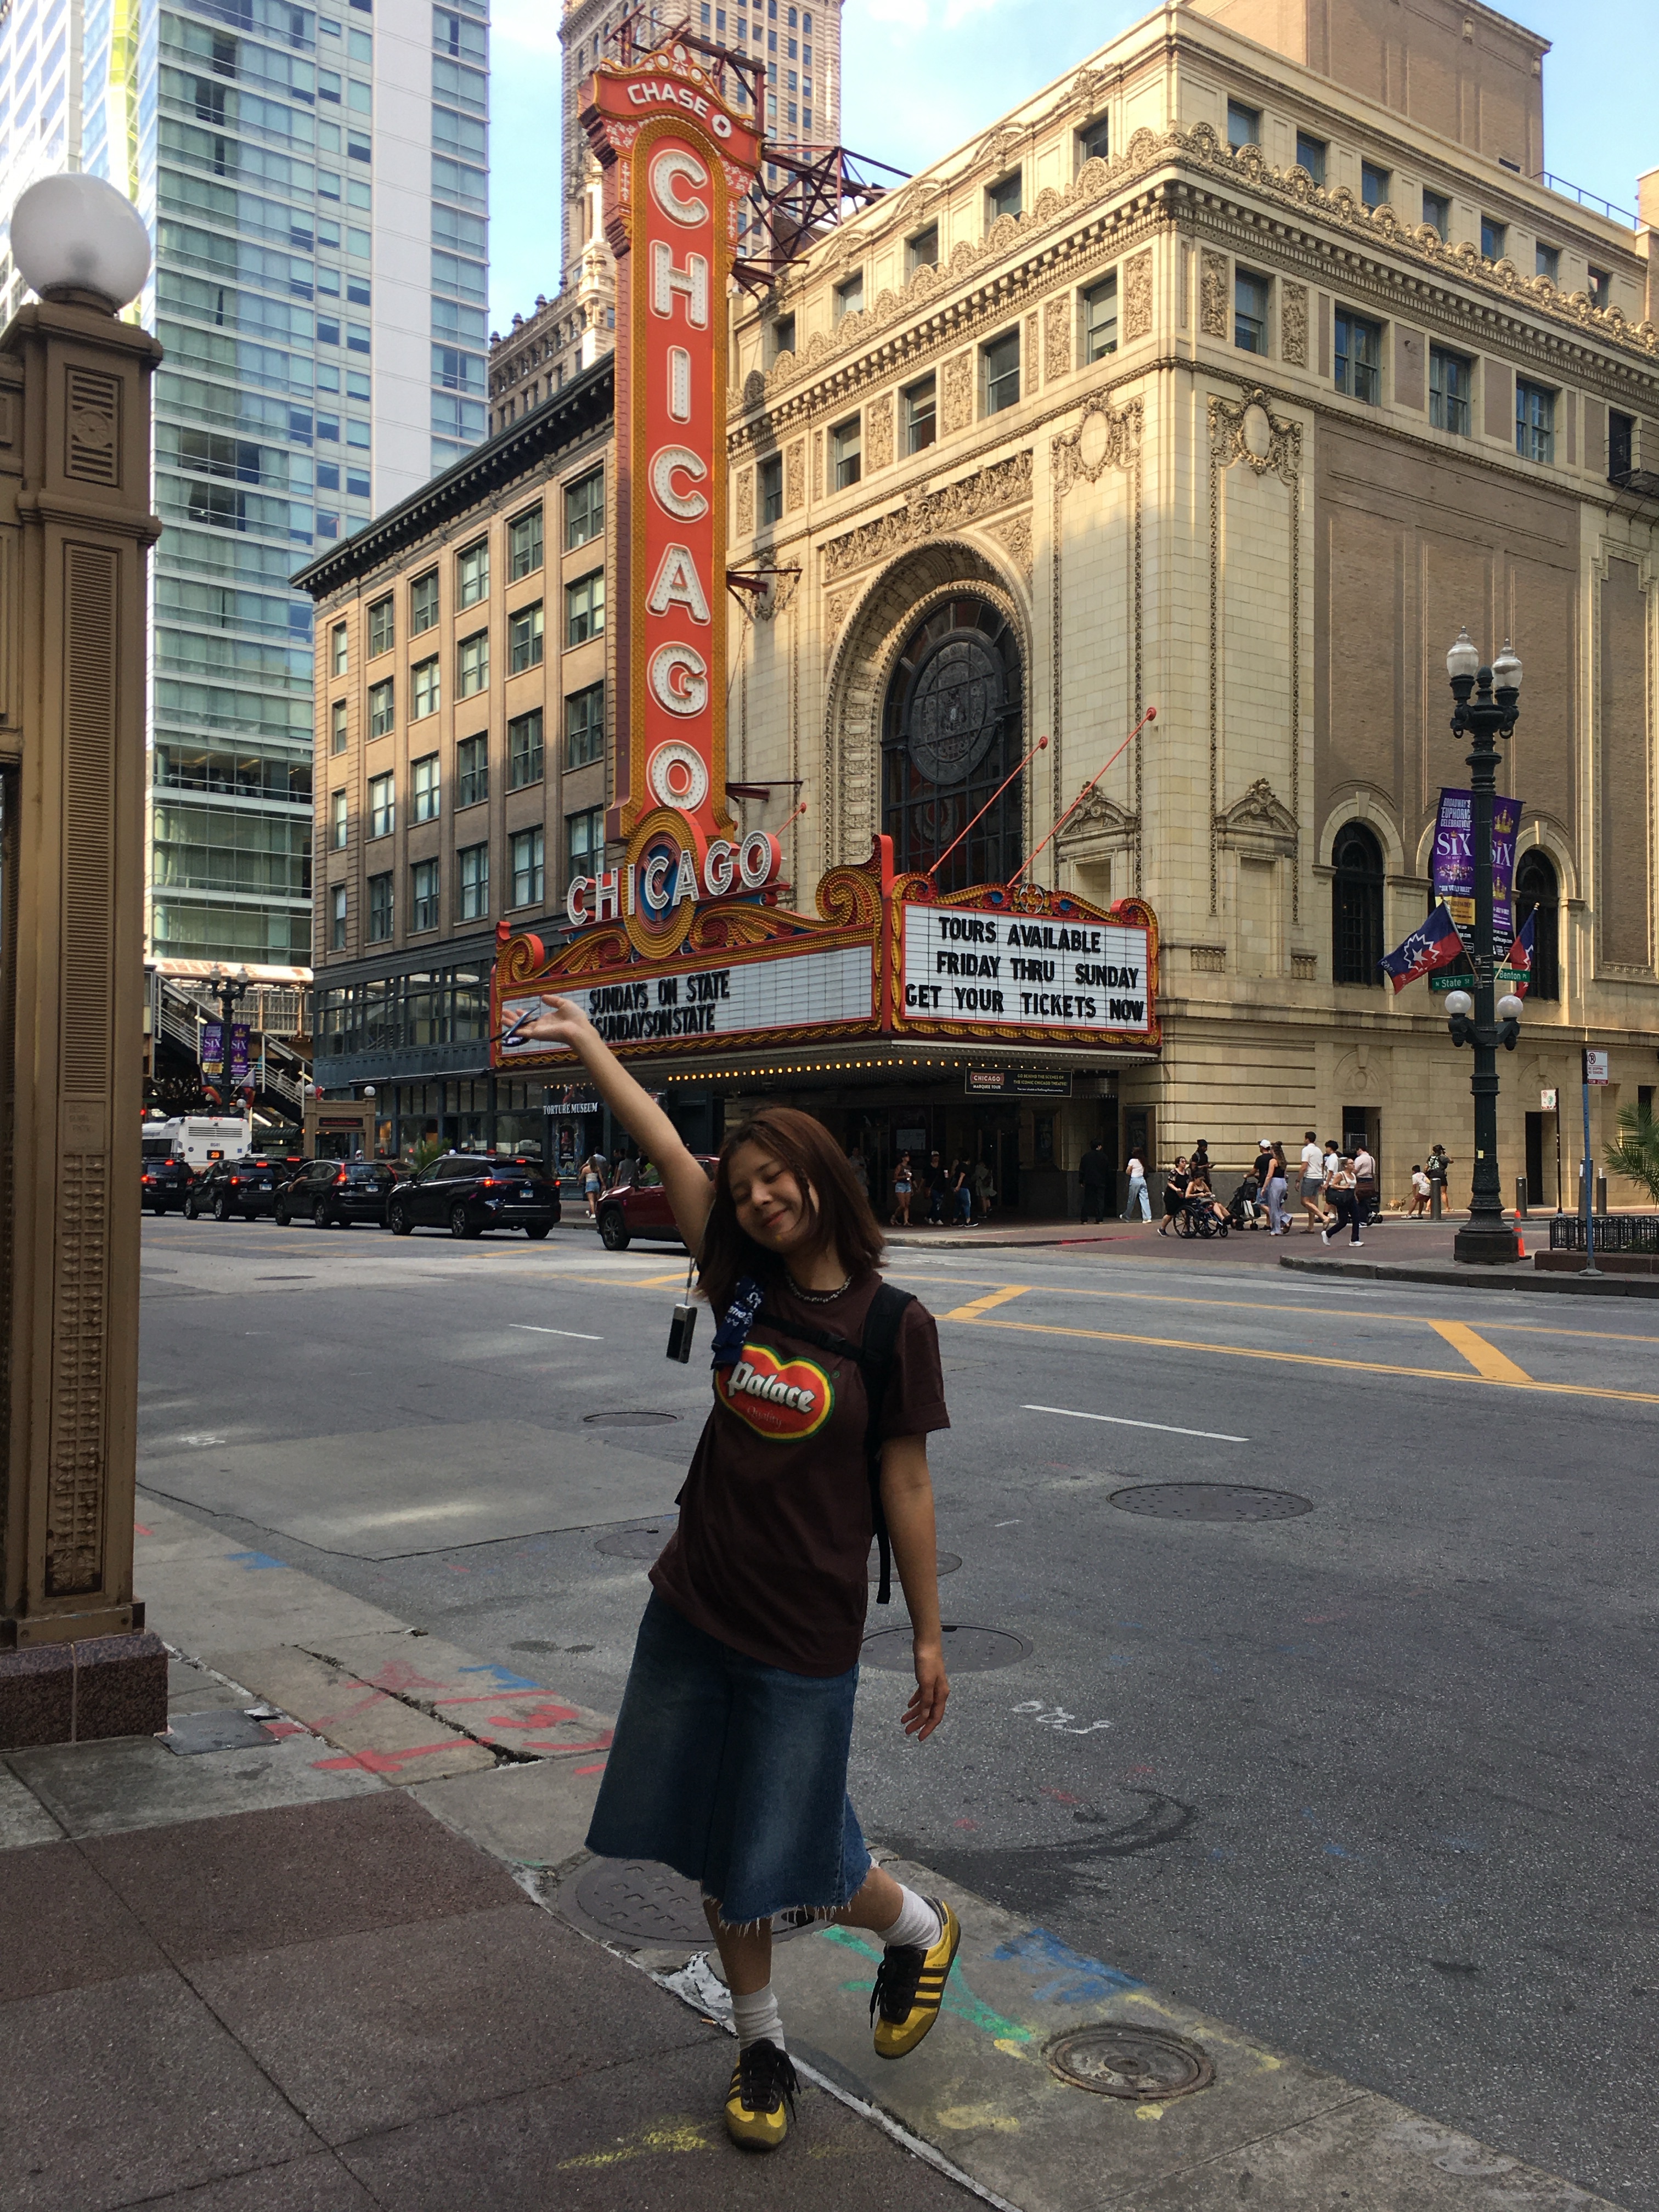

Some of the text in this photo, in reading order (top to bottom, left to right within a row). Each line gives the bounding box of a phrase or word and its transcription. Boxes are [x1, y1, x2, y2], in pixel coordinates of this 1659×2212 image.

[627, 81, 710, 120] CHASE
[645, 148, 712, 812] CHICAGO
[1436, 832, 1472, 856] SIX
[567, 830, 773, 926] CHICAGO
[938, 916, 1101, 953] TOURS AVAILABLE
[936, 951, 1139, 989] FRIDAY THRU SUNDAY
[1441, 979, 1462, 988] State
[1499, 970, 1521, 980] Benton
[589, 970, 730, 1015] SUNDAYS ON STATE
[905, 983, 1144, 1022] GET YOUR TICKETS NOW
[543, 1102, 599, 1115] TORTURE MUSEUM
[728, 1361, 816, 1413] Palace
[747, 1405, 782, 1430] Quality
